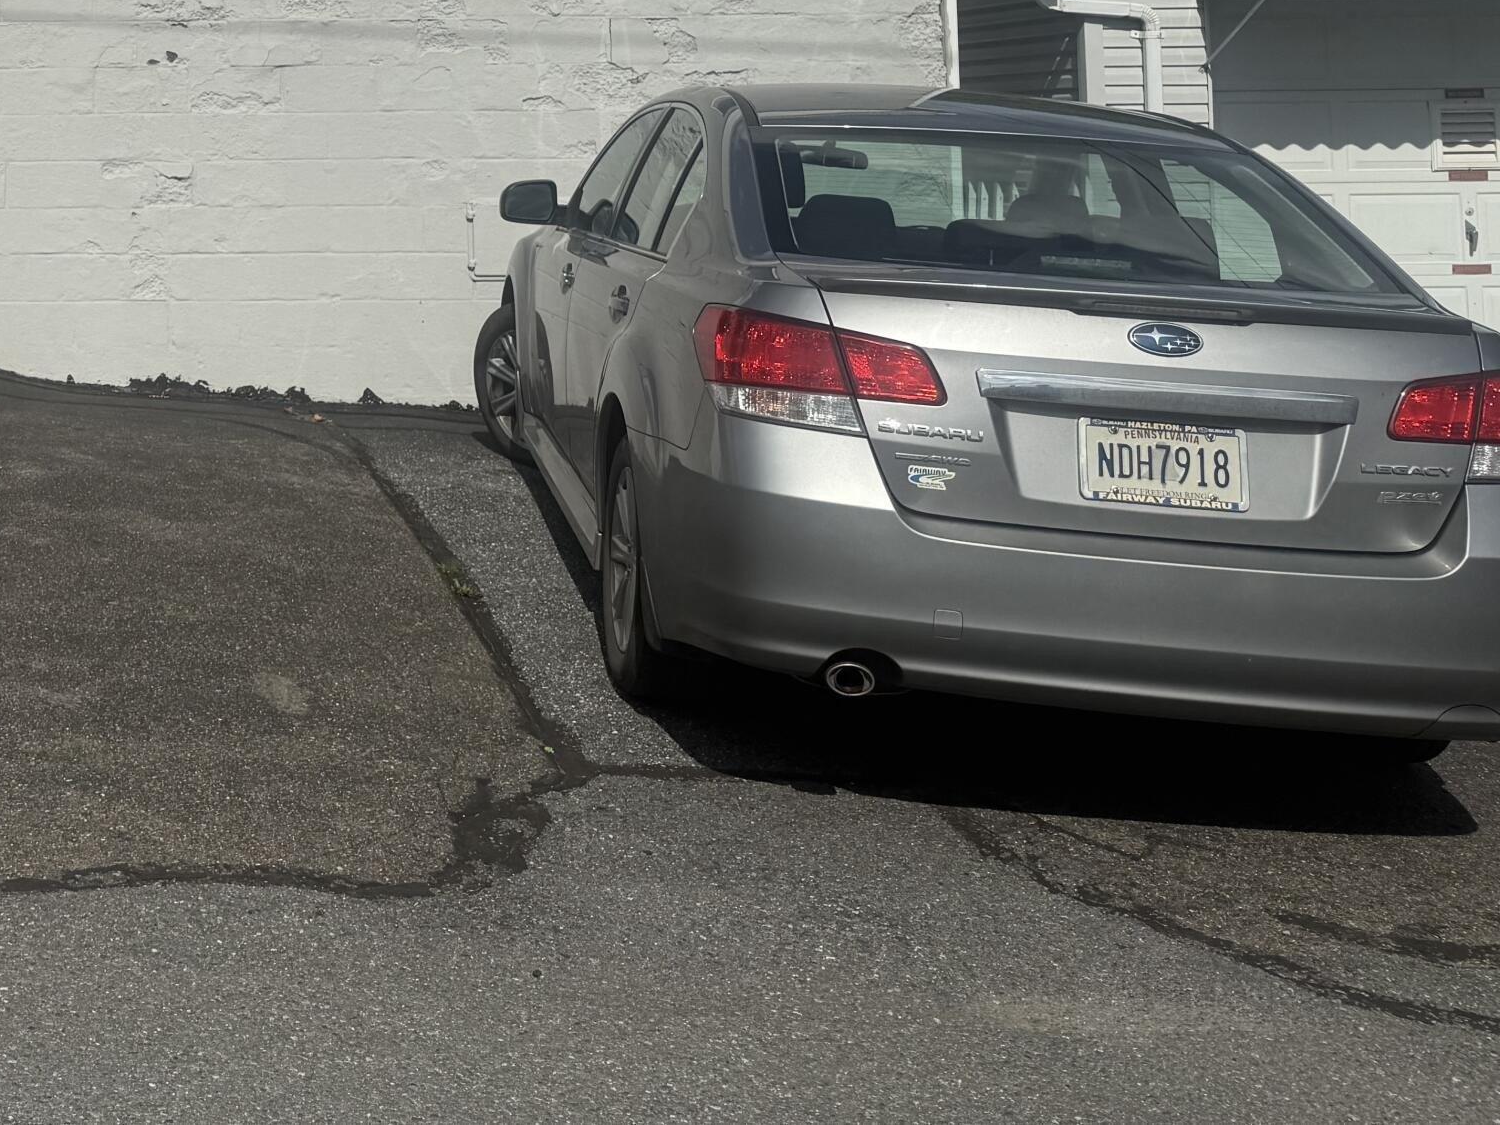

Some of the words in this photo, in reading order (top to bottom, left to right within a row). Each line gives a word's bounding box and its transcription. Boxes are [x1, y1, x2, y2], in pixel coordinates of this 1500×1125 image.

[877, 420, 984, 443] SUBARU
[1124, 429, 1200, 445] PENNSYLVANIA
[1184, 425, 1198, 433] PA
[1097, 441, 1230, 489] NDH7918
[1360, 462, 1453, 478] LEGACY
[1098, 491, 1165, 504] FAIRWAY
[1171, 498, 1233, 510] SUBARU
